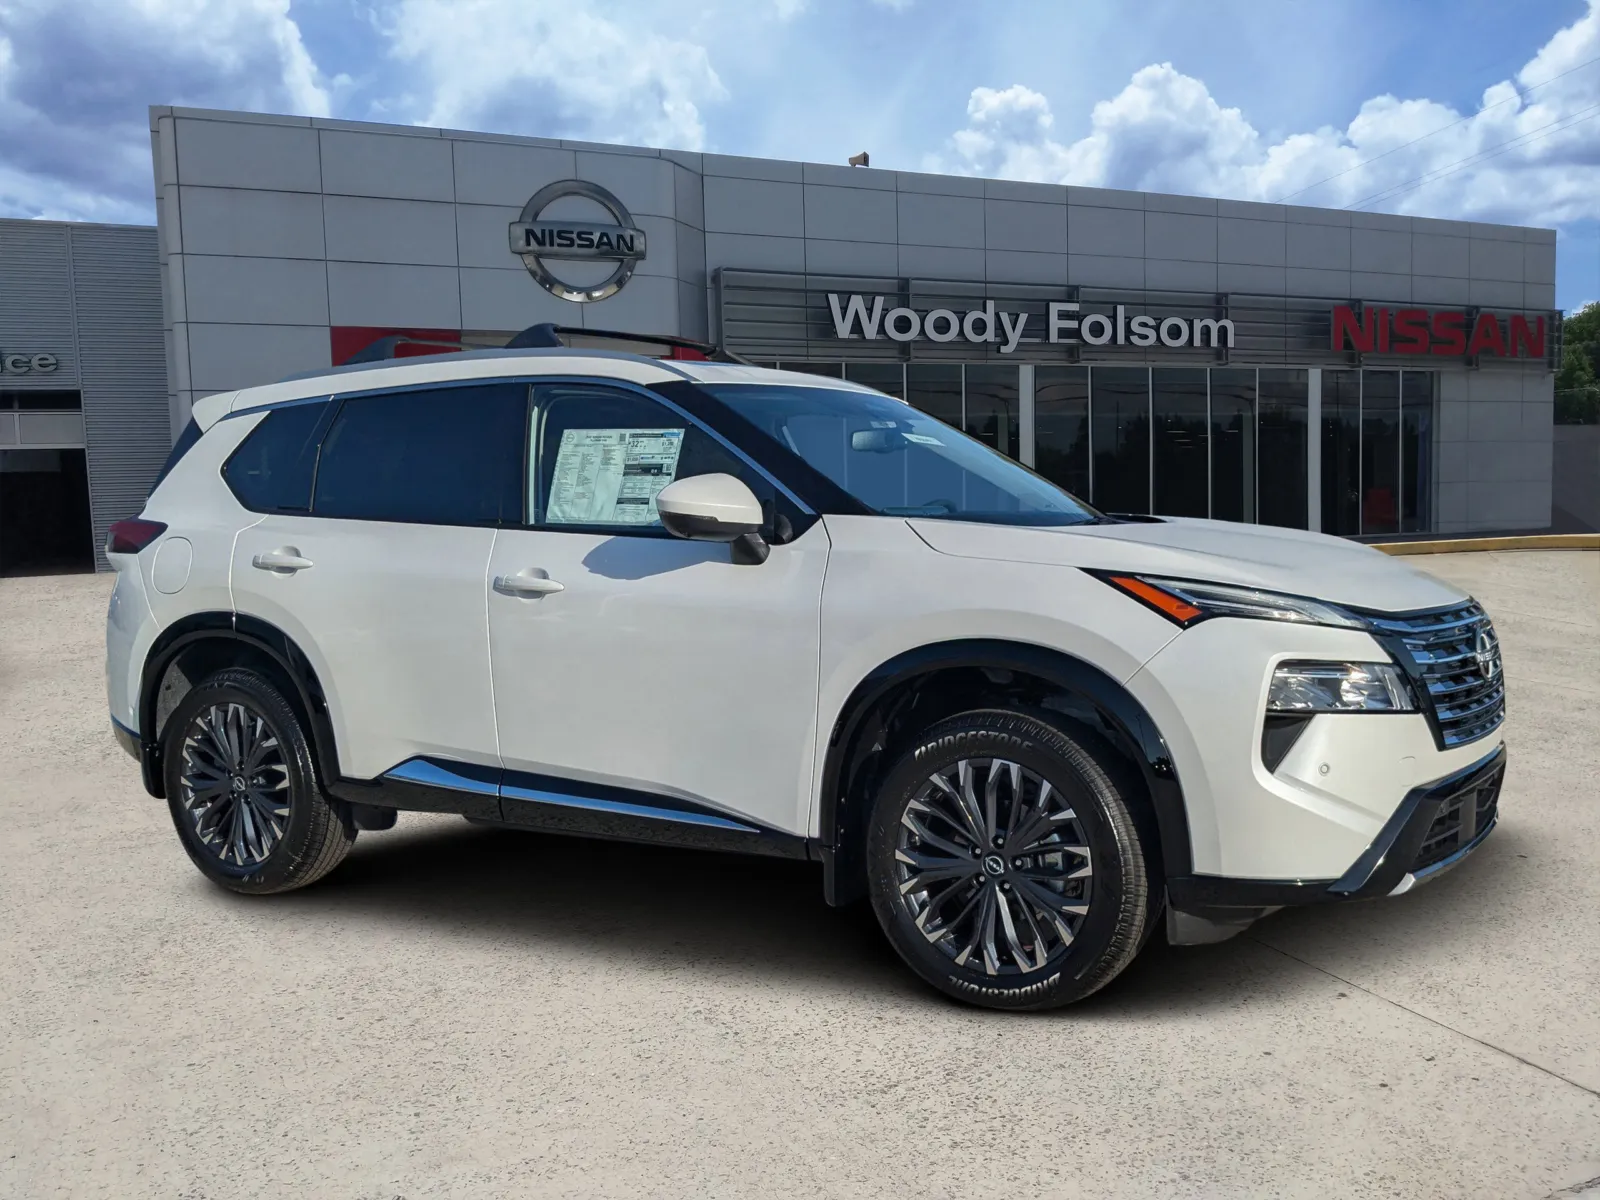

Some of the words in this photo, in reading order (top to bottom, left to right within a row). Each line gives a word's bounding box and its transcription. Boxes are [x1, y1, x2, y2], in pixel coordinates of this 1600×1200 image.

[525, 228, 635, 252] NISSAN
[827, 293, 1029, 354] Woody
[1047, 301, 1236, 348] Folsom
[1332, 304, 1546, 359] NISSAN
[0, 353, 57, 374] ce
[1476, 649, 1497, 662] NIS
